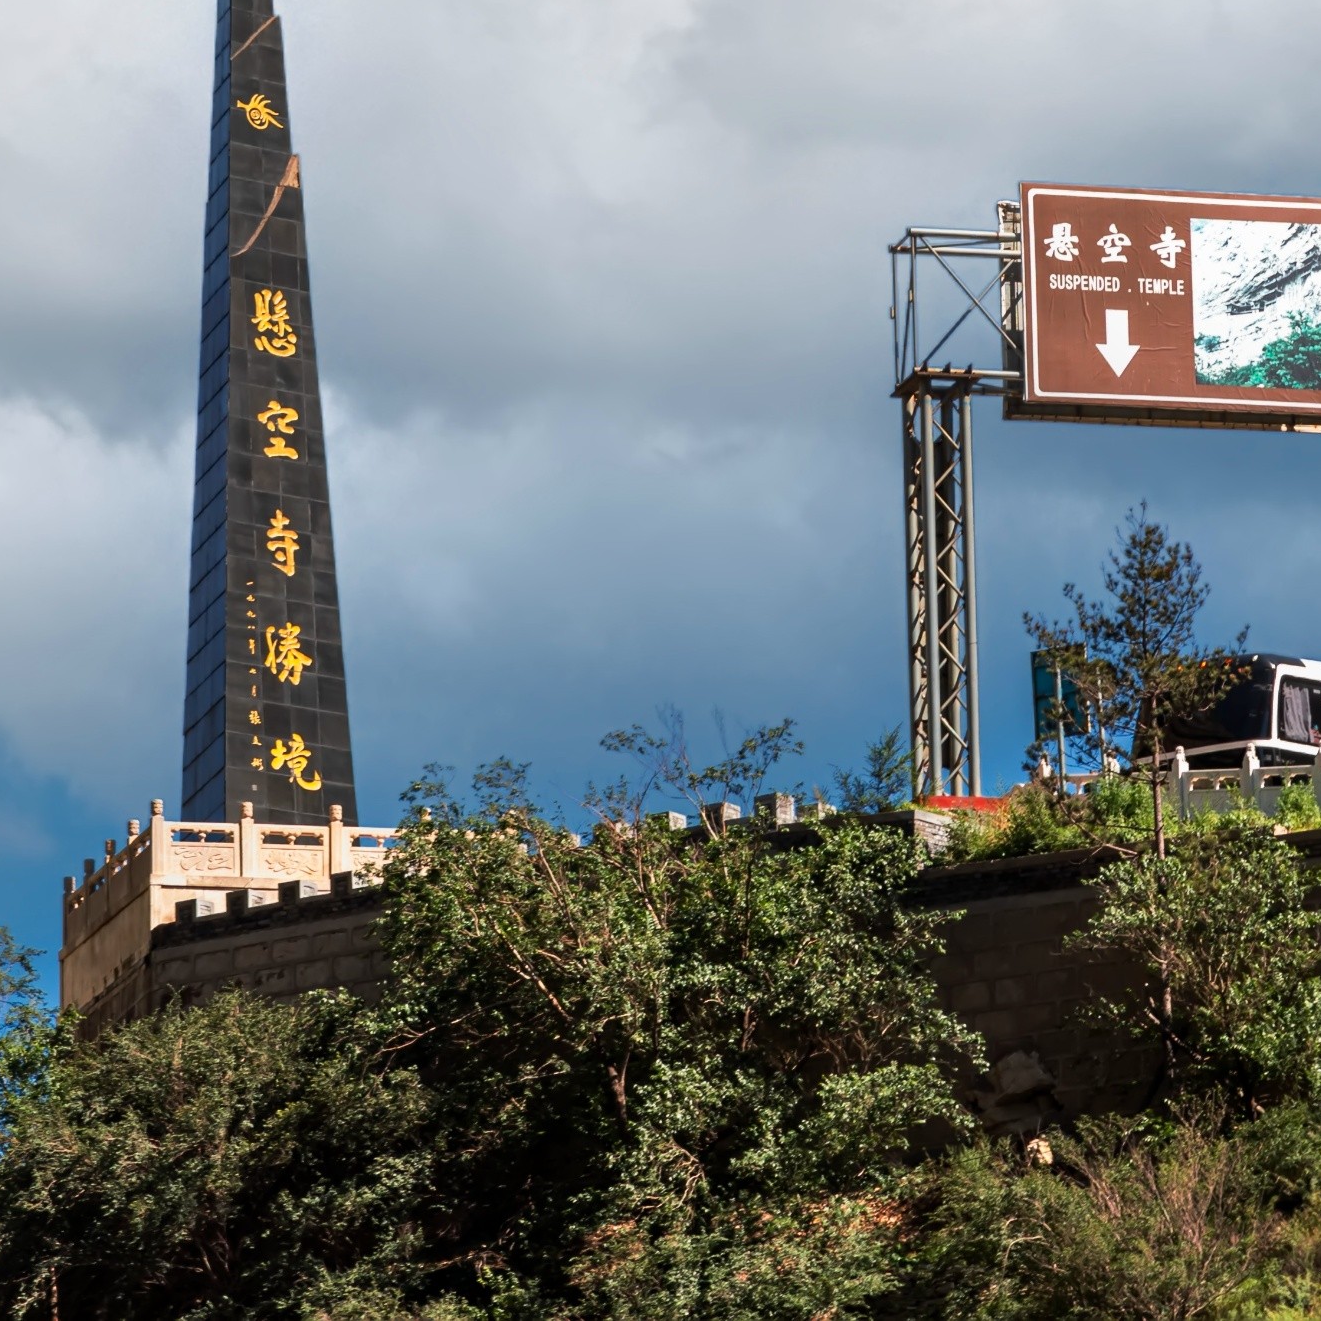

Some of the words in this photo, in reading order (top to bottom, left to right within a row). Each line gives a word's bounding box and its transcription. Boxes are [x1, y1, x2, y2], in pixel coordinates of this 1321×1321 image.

[1043, 222, 1187, 269] 悬空寺
[1048, 273, 1121, 293] SUSPENDED
[1137, 277, 1185, 296] TEMPLE
[251, 289, 322, 791] 懸空寺勝境
